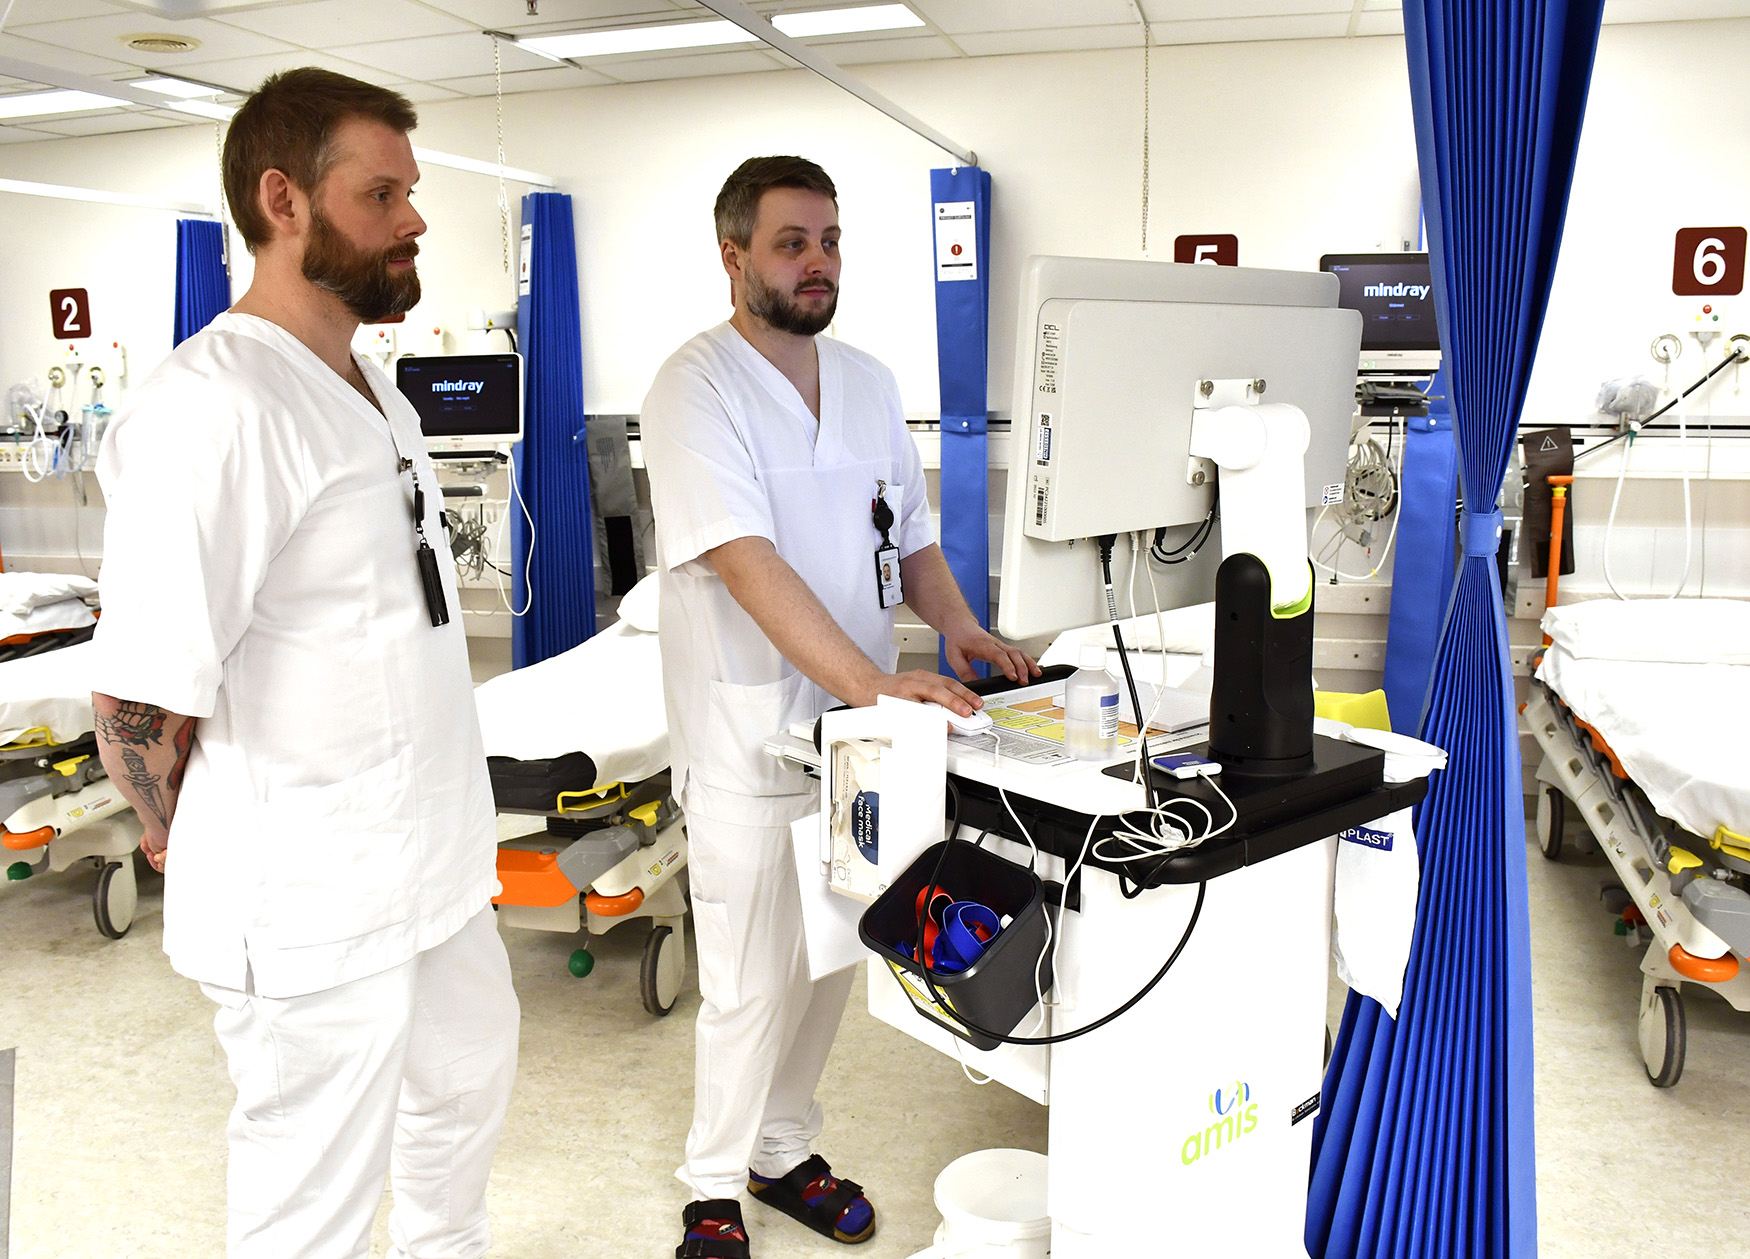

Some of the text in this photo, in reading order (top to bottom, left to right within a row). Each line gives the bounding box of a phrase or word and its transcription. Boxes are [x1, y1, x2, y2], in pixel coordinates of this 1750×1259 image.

[1693, 237, 1726, 286] 6
[1364, 282, 1431, 300] mindray
[61, 296, 81, 331] 2
[432, 379, 484, 394] mindray
[865, 804, 873, 845] Medical
[1181, 1103, 1258, 1166] amis
